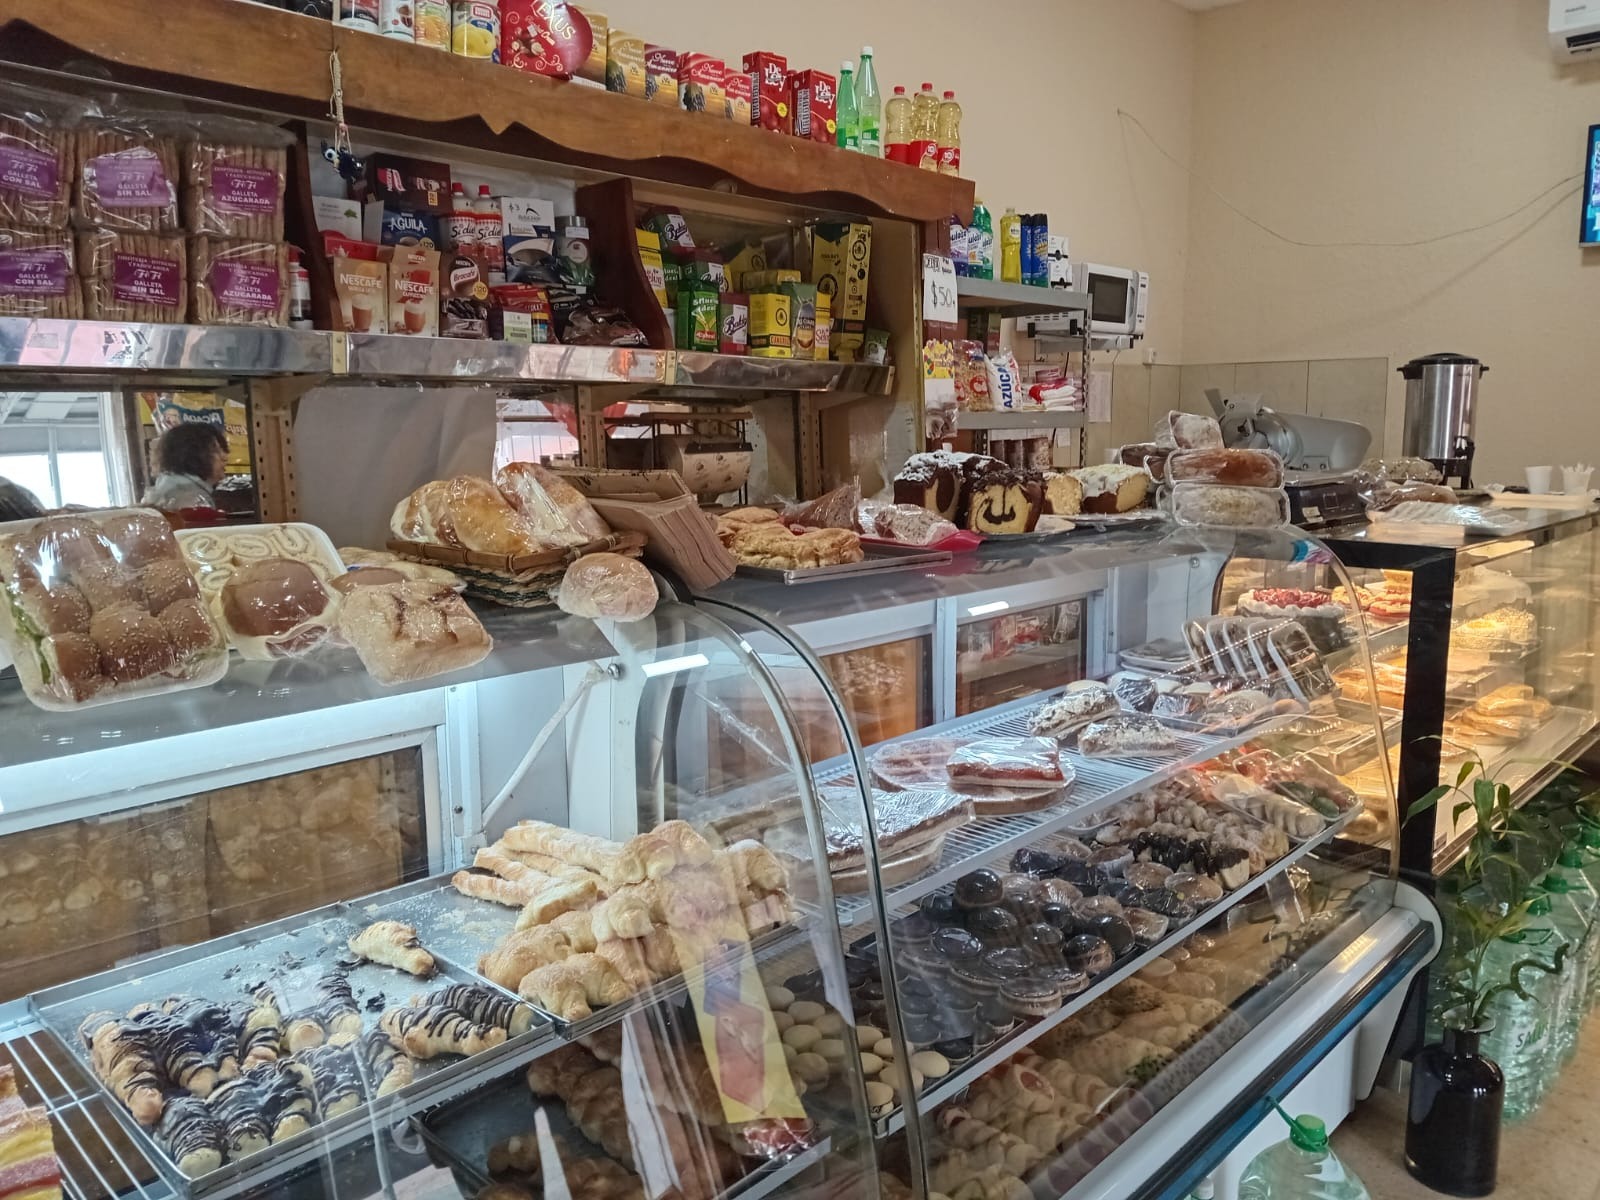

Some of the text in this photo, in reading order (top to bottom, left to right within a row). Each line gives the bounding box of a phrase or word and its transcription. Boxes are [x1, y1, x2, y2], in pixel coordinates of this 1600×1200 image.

[221, 195, 271, 206] AZUCARADA
[133, 280, 163, 289] GALLETA
[149, 288, 166, 296] SAL
[223, 289, 273, 301] AZUCARADA
[997, 365, 1013, 409] AZÚC
